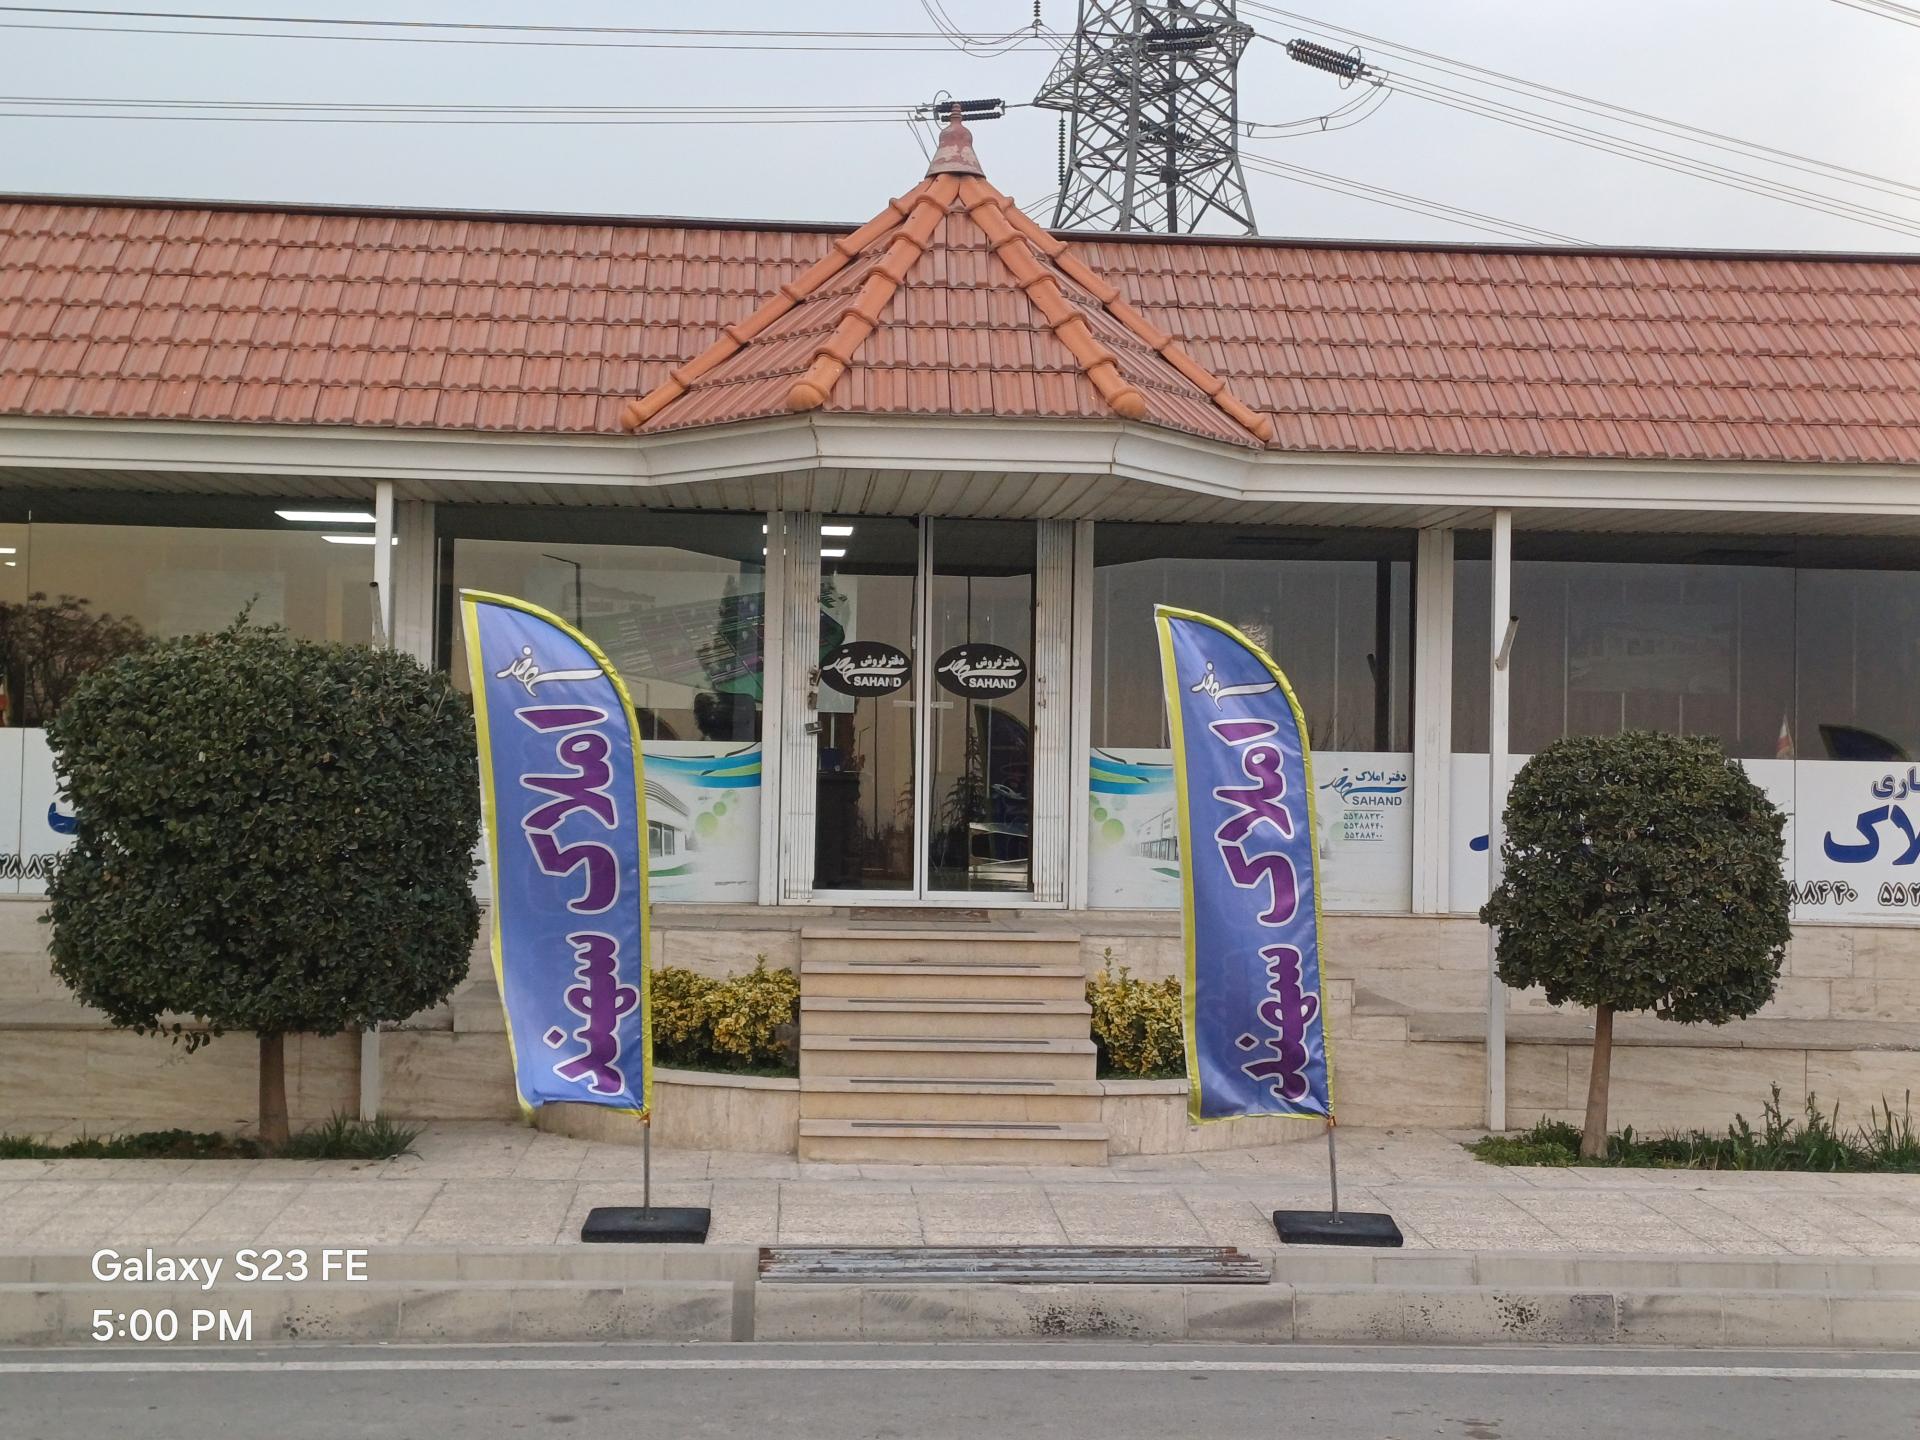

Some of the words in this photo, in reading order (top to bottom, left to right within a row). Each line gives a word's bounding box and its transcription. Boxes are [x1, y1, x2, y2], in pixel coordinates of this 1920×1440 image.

[859, 653, 885, 668] فروش
[975, 654, 1001, 669] فروش
[853, 676, 902, 688] SAHAND
[968, 677, 1017, 689] SAHAND
[1355, 770, 1384, 782] املاک
[1386, 770, 1407, 785] دفتر
[1352, 796, 1402, 806] SAHAND
[514, 704, 620, 915] املاک
[1208, 718, 1299, 927] املاک
[543, 931, 640, 1096] سهند
[1235, 943, 1321, 1103] سهند
